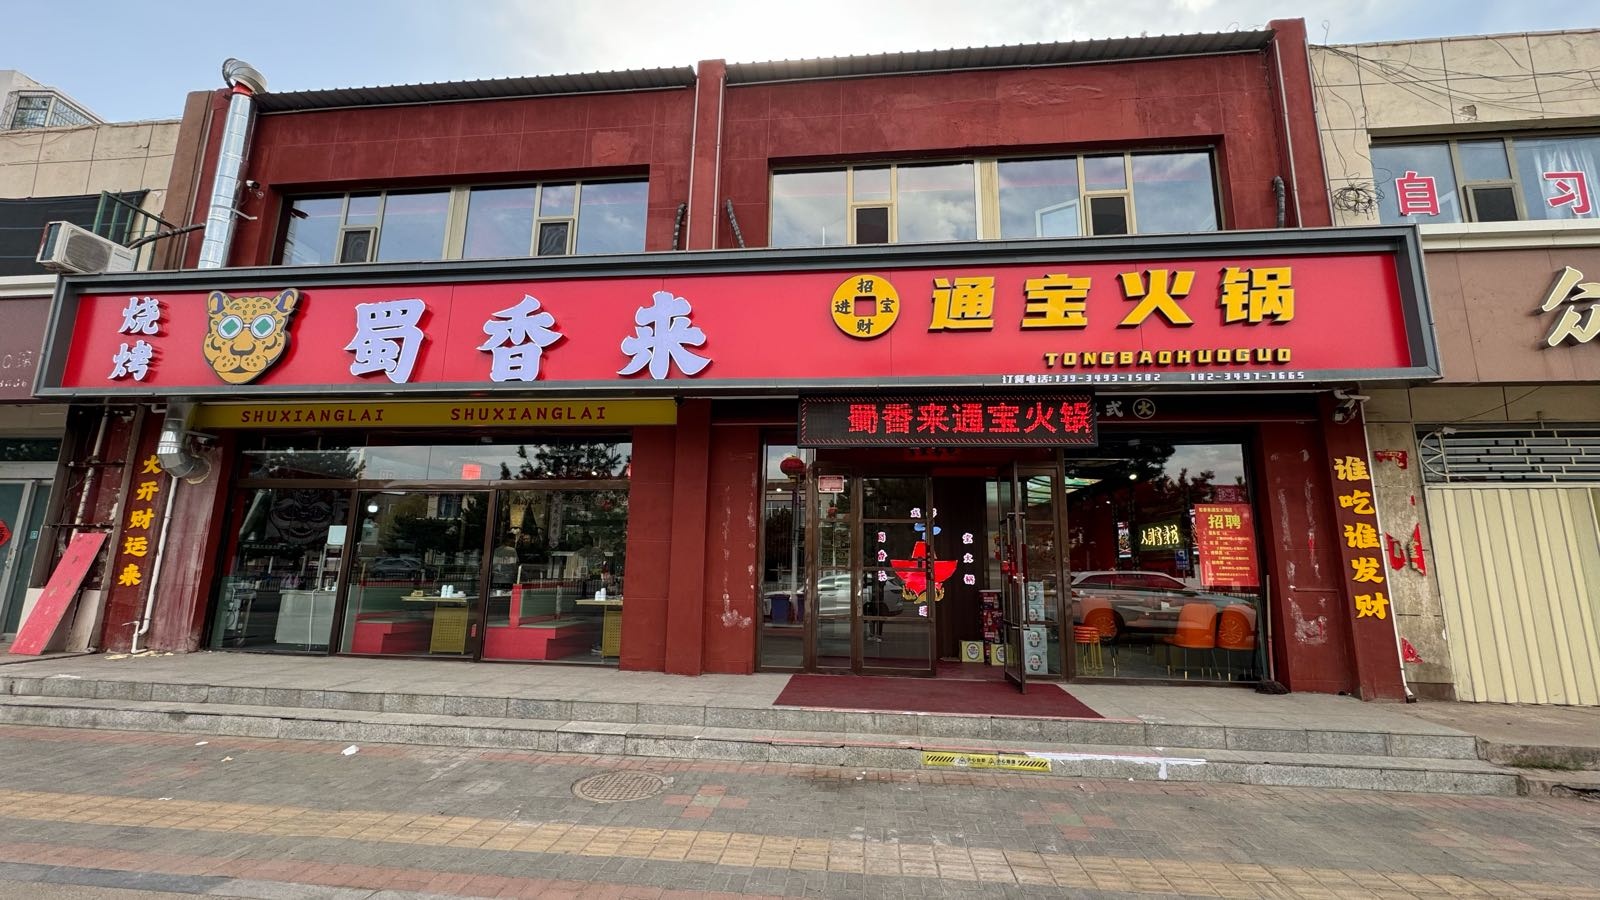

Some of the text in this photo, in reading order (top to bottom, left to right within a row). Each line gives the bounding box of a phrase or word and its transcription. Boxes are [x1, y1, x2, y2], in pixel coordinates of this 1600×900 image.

[1395, 171, 1593, 217] 自习
[929, 266, 1296, 329] 通宝火锅
[108, 296, 162, 381] 烧烤
[345, 291, 712, 383] 蜀香来
[1046, 348, 1291, 367] TONGBAOHUOGUO
[240, 406, 607, 423] SHUXIANGLAI SHUXIANGLAI
[848, 402, 1090, 434] 蜀香来通宝火锅
[1208, 514, 1241, 529] 招聘
[1333, 456, 1389, 620] 谁吃谁发财
